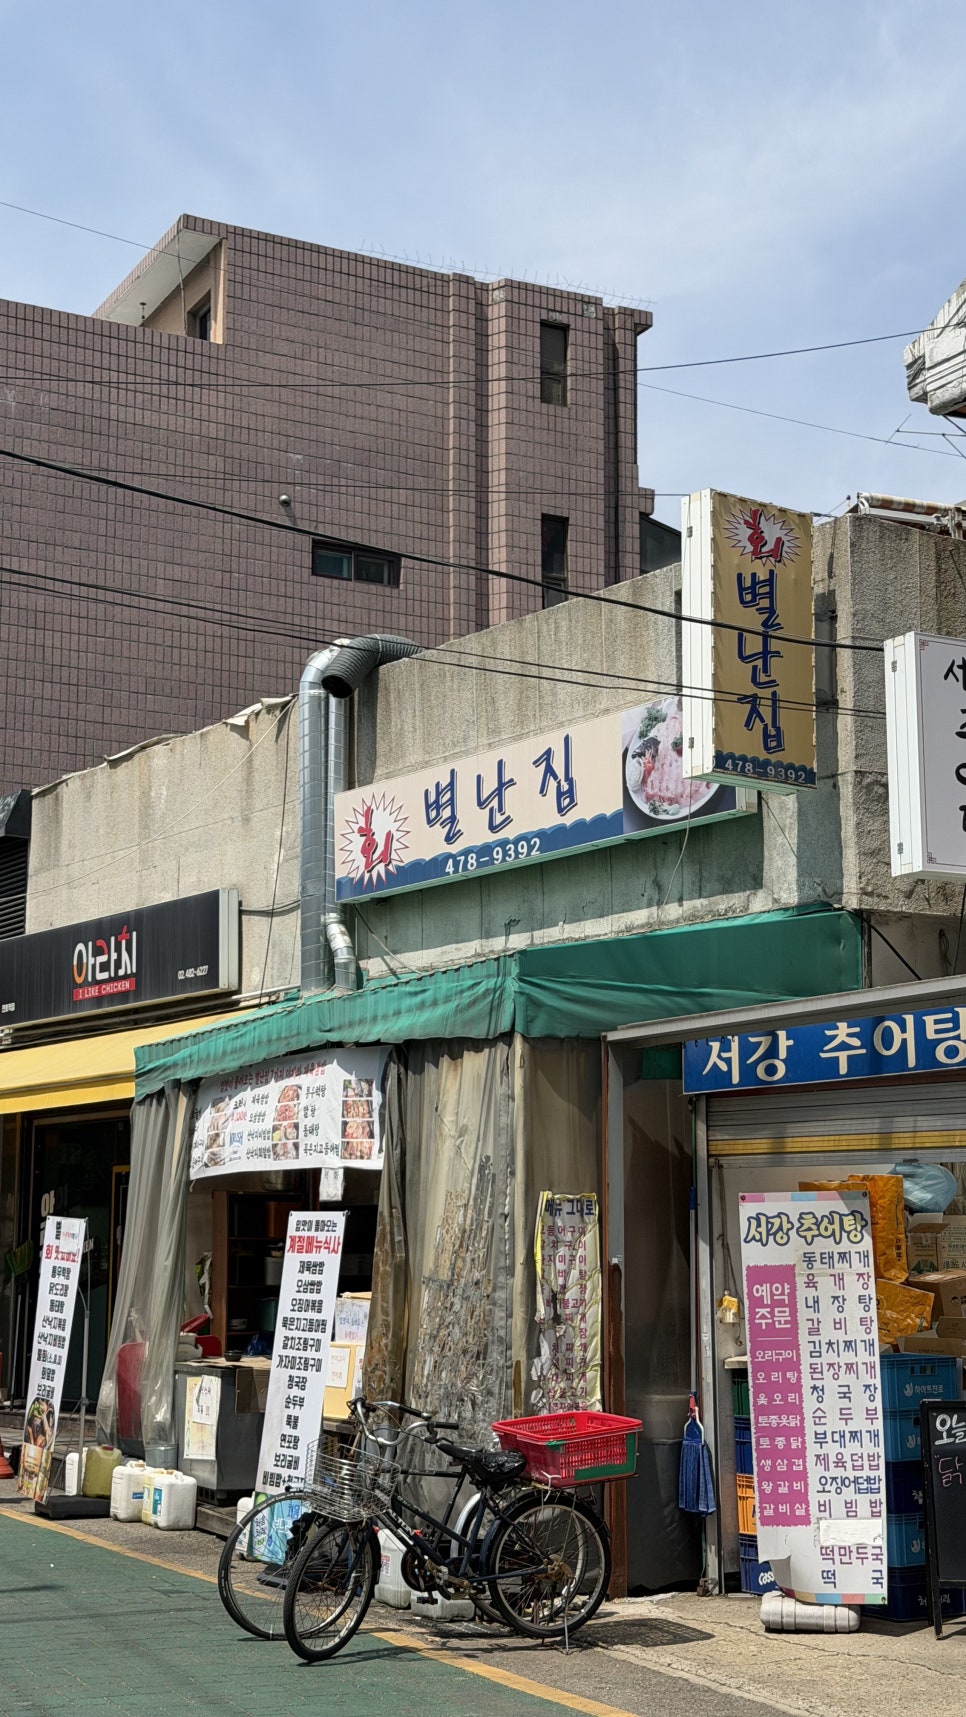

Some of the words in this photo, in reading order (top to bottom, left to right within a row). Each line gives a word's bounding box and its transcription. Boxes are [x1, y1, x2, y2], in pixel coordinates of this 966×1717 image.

[743, 508, 783, 561] 회
[737, 568, 786, 754] 별난집
[725, 759, 806, 783] 478-9392
[424, 733, 577, 844] 별난집
[357, 806, 392, 874] 회
[445, 837, 541, 876] 478-9392
[73, 925, 137, 984] 아라치
[84, 985, 99, 998] LIKE
[101, 981, 130, 994] CHICKEN
[702, 1030, 794, 1085] 서강
[819, 1007, 966, 1075] 추어탕
[295, 1220, 314, 1232] 입맛이
[314, 1220, 338, 1232] 돌아오는
[744, 1211, 794, 1246] 서강
[796, 1209, 868, 1246] 추어탕
[287, 1235, 341, 1255] 계절메뉴식사
[298, 1260, 325, 1275] 제육쌈밥
[802, 1250, 870, 1270] 동태찌개
[296, 1279, 323, 1294] 오삼쌈밥
[803, 1271, 872, 1292] 육개장
[753, 1283, 791, 1305] 예약
[290, 1298, 324, 1314] 오징어볶음
[805, 1294, 873, 1315] 내장탕
[281, 1316, 327, 1334] 묵은지고등어찜
[754, 1307, 791, 1329] 주문
[806, 1316, 875, 1337] 갈비탕
[282, 1336, 322, 1353] 갈치조림구이
[808, 1338, 875, 1360] 김치찌개
[276, 1354, 323, 1373] 가자미조림구이
[754, 1349, 797, 1362] 오리구이
[755, 1371, 798, 1383] 오리탕
[809, 1361, 877, 1381] 된장찌개
[287, 1374, 308, 1391] 청국장
[914, 1383, 944, 1395] 하이트진로
[285, 1394, 305, 1411] 순두부
[810, 1383, 878, 1404] 청국장
[812, 1406, 879, 1427] 순두부
[280, 1433, 300, 1451] 연포탕
[759, 1436, 802, 1449] 토종닭
[813, 1429, 880, 1449] 부대찌개
[274, 1452, 301, 1471] 보리굴비
[760, 1458, 803, 1472] 생삼겹
[814, 1452, 881, 1472] 제육덮밥
[761, 1480, 805, 1494] 왕갈비
[816, 1475, 882, 1496] 오징어덮밥
[762, 1502, 807, 1516] 갈비살
[818, 1498, 883, 1518] 비빔밥
[820, 1545, 884, 1566] 떡만두국
